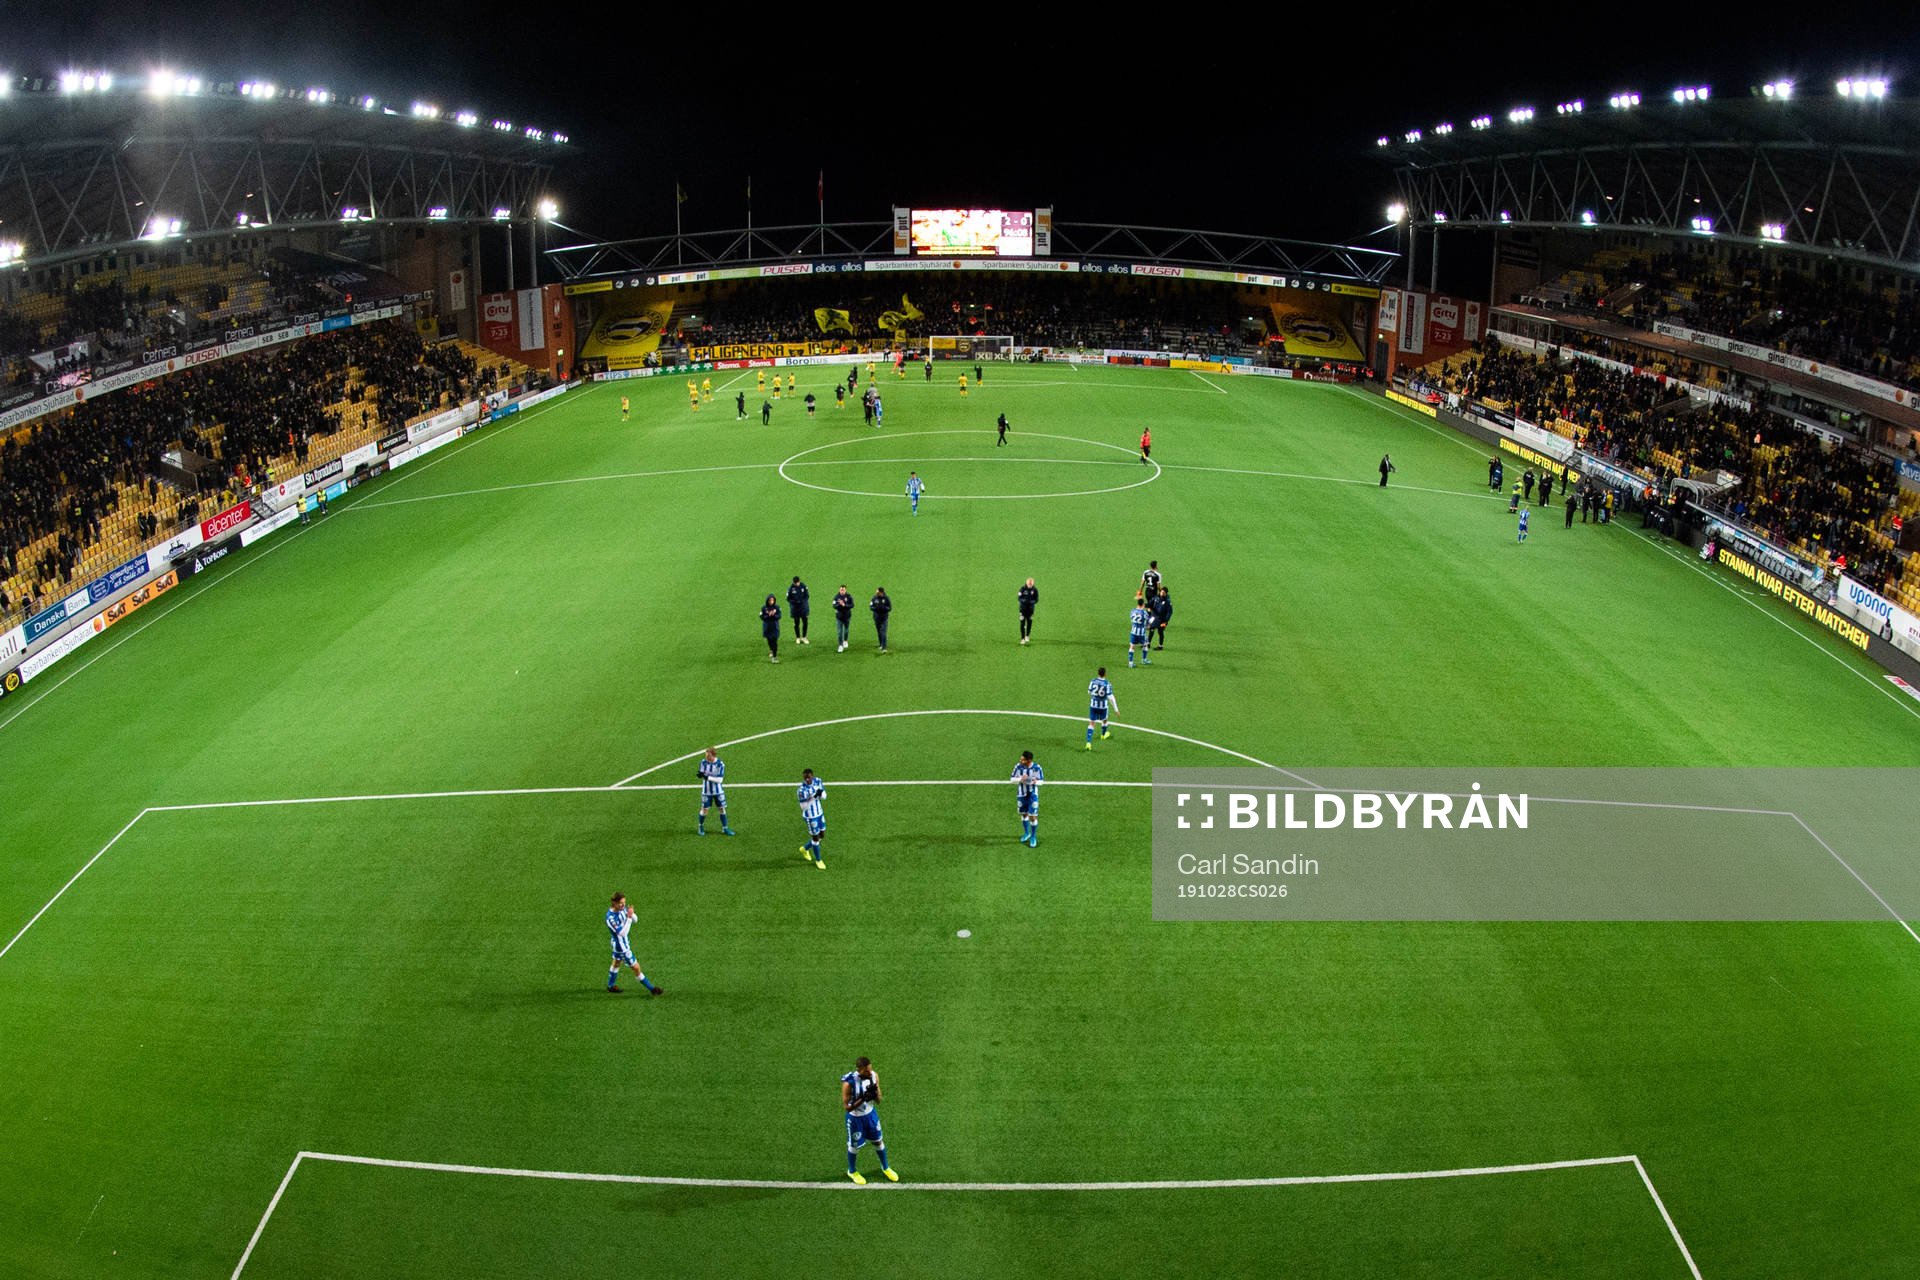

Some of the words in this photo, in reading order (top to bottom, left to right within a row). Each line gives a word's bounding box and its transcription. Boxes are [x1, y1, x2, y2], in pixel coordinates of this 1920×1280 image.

[764, 265, 810, 275] PULSEN
[815, 263, 836, 273] ellos
[842, 262, 863, 272] ellos
[876, 261, 918, 270] Sparbanken
[983, 262, 1025, 271] Sparbanken
[1027, 262, 1059, 271] Sjuhärad
[1082, 262, 1103, 272] ellos
[1108, 263, 1129, 274] ellos
[1134, 266, 1181, 277] PULSEN
[184, 346, 221, 366] PULSEN
[102, 372, 140, 391] Sparbanken
[0, 405, 41, 428] Sparbanken
[42, 393, 75, 413] Sjuhärad
[1499, 438, 1520, 456] STANNA
[1520, 446, 1535, 464] KVAR
[1534, 453, 1553, 471] EFTER
[1552, 461, 1580, 484] MATHEN
[208, 508, 245, 537] elcenter
[1718, 548, 1756, 581] STANNA
[1756, 565, 1784, 597] KVAR
[1783, 585, 1816, 621] EFTER
[1815, 605, 1870, 651] MATCHEN
[1850, 583, 1894, 620] uponor
[34, 609, 66, 633] Danske
[68, 596, 88, 613] Bank
[1132, 612, 1144, 624] 22
[23, 645, 65, 679] Sparbanken
[1092, 683, 1106, 697] 26
